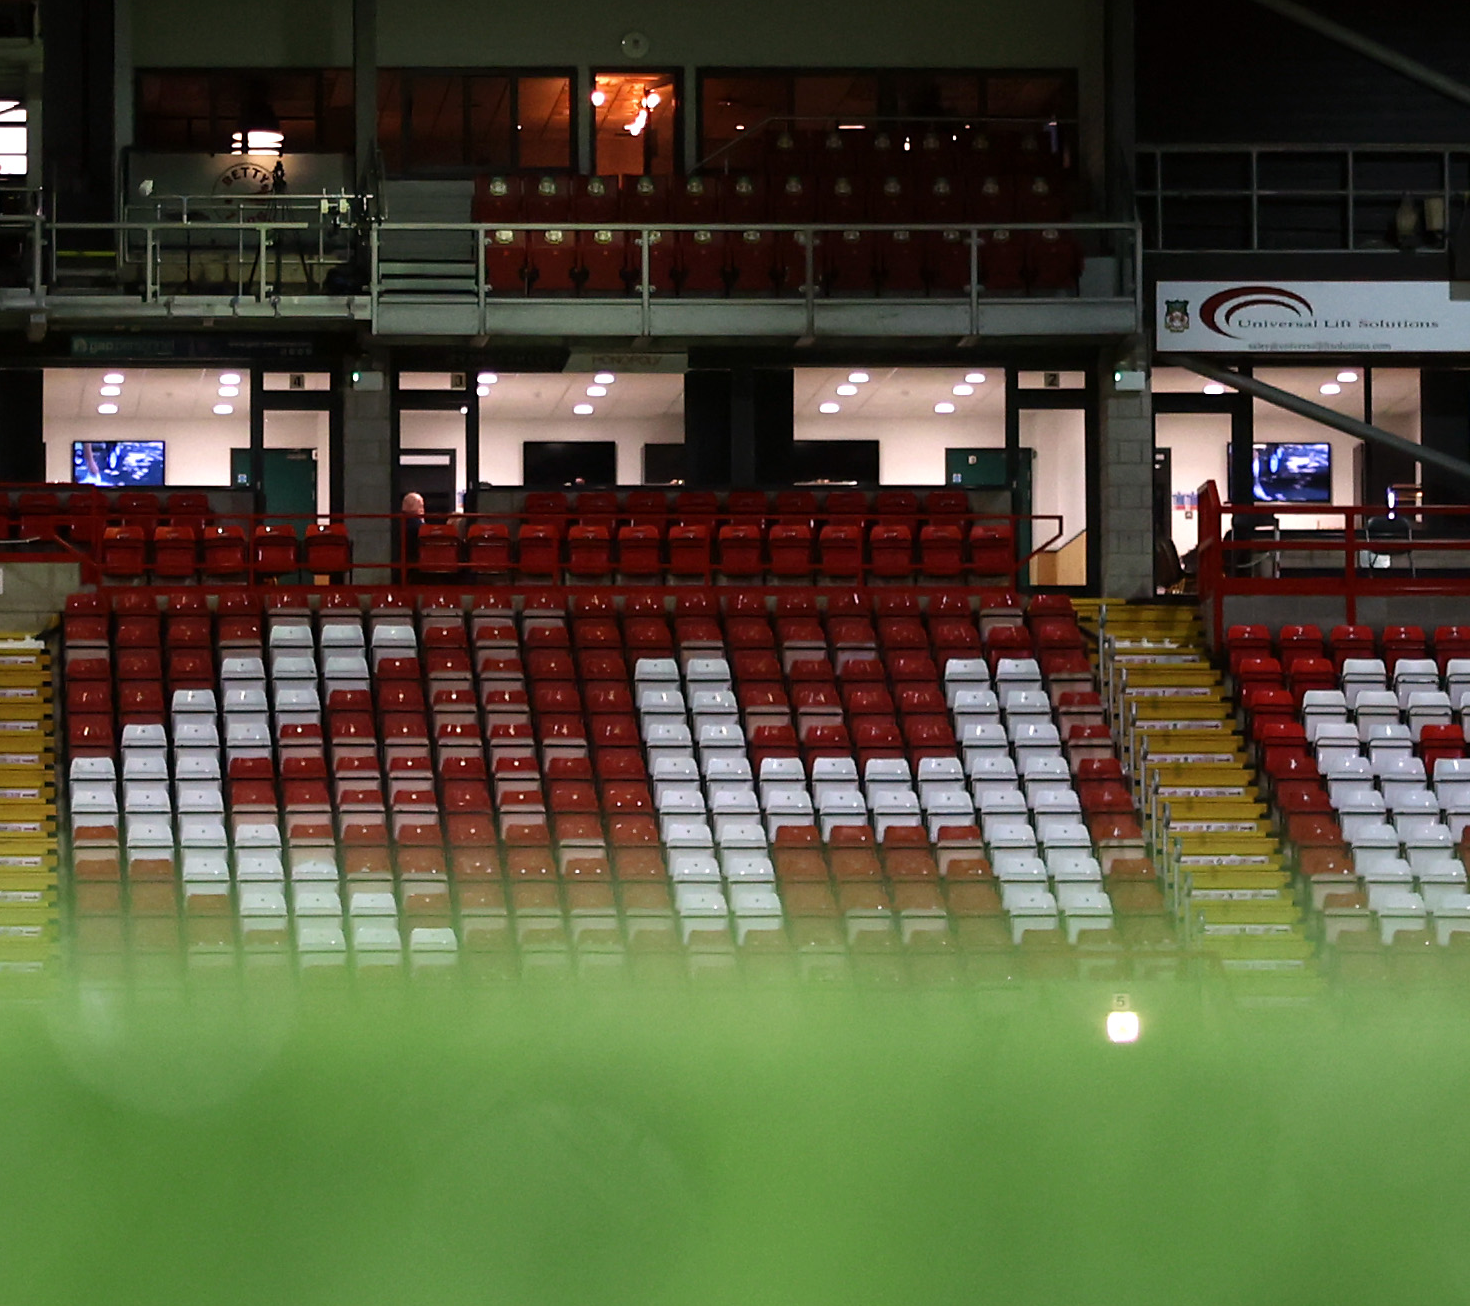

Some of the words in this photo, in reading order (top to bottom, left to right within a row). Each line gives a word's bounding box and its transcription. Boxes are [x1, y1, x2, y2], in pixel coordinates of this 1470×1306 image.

[1238, 319, 1316, 329] Universal
[1324, 319, 1351, 329] Lift
[1358, 319, 1439, 329] Solutions
